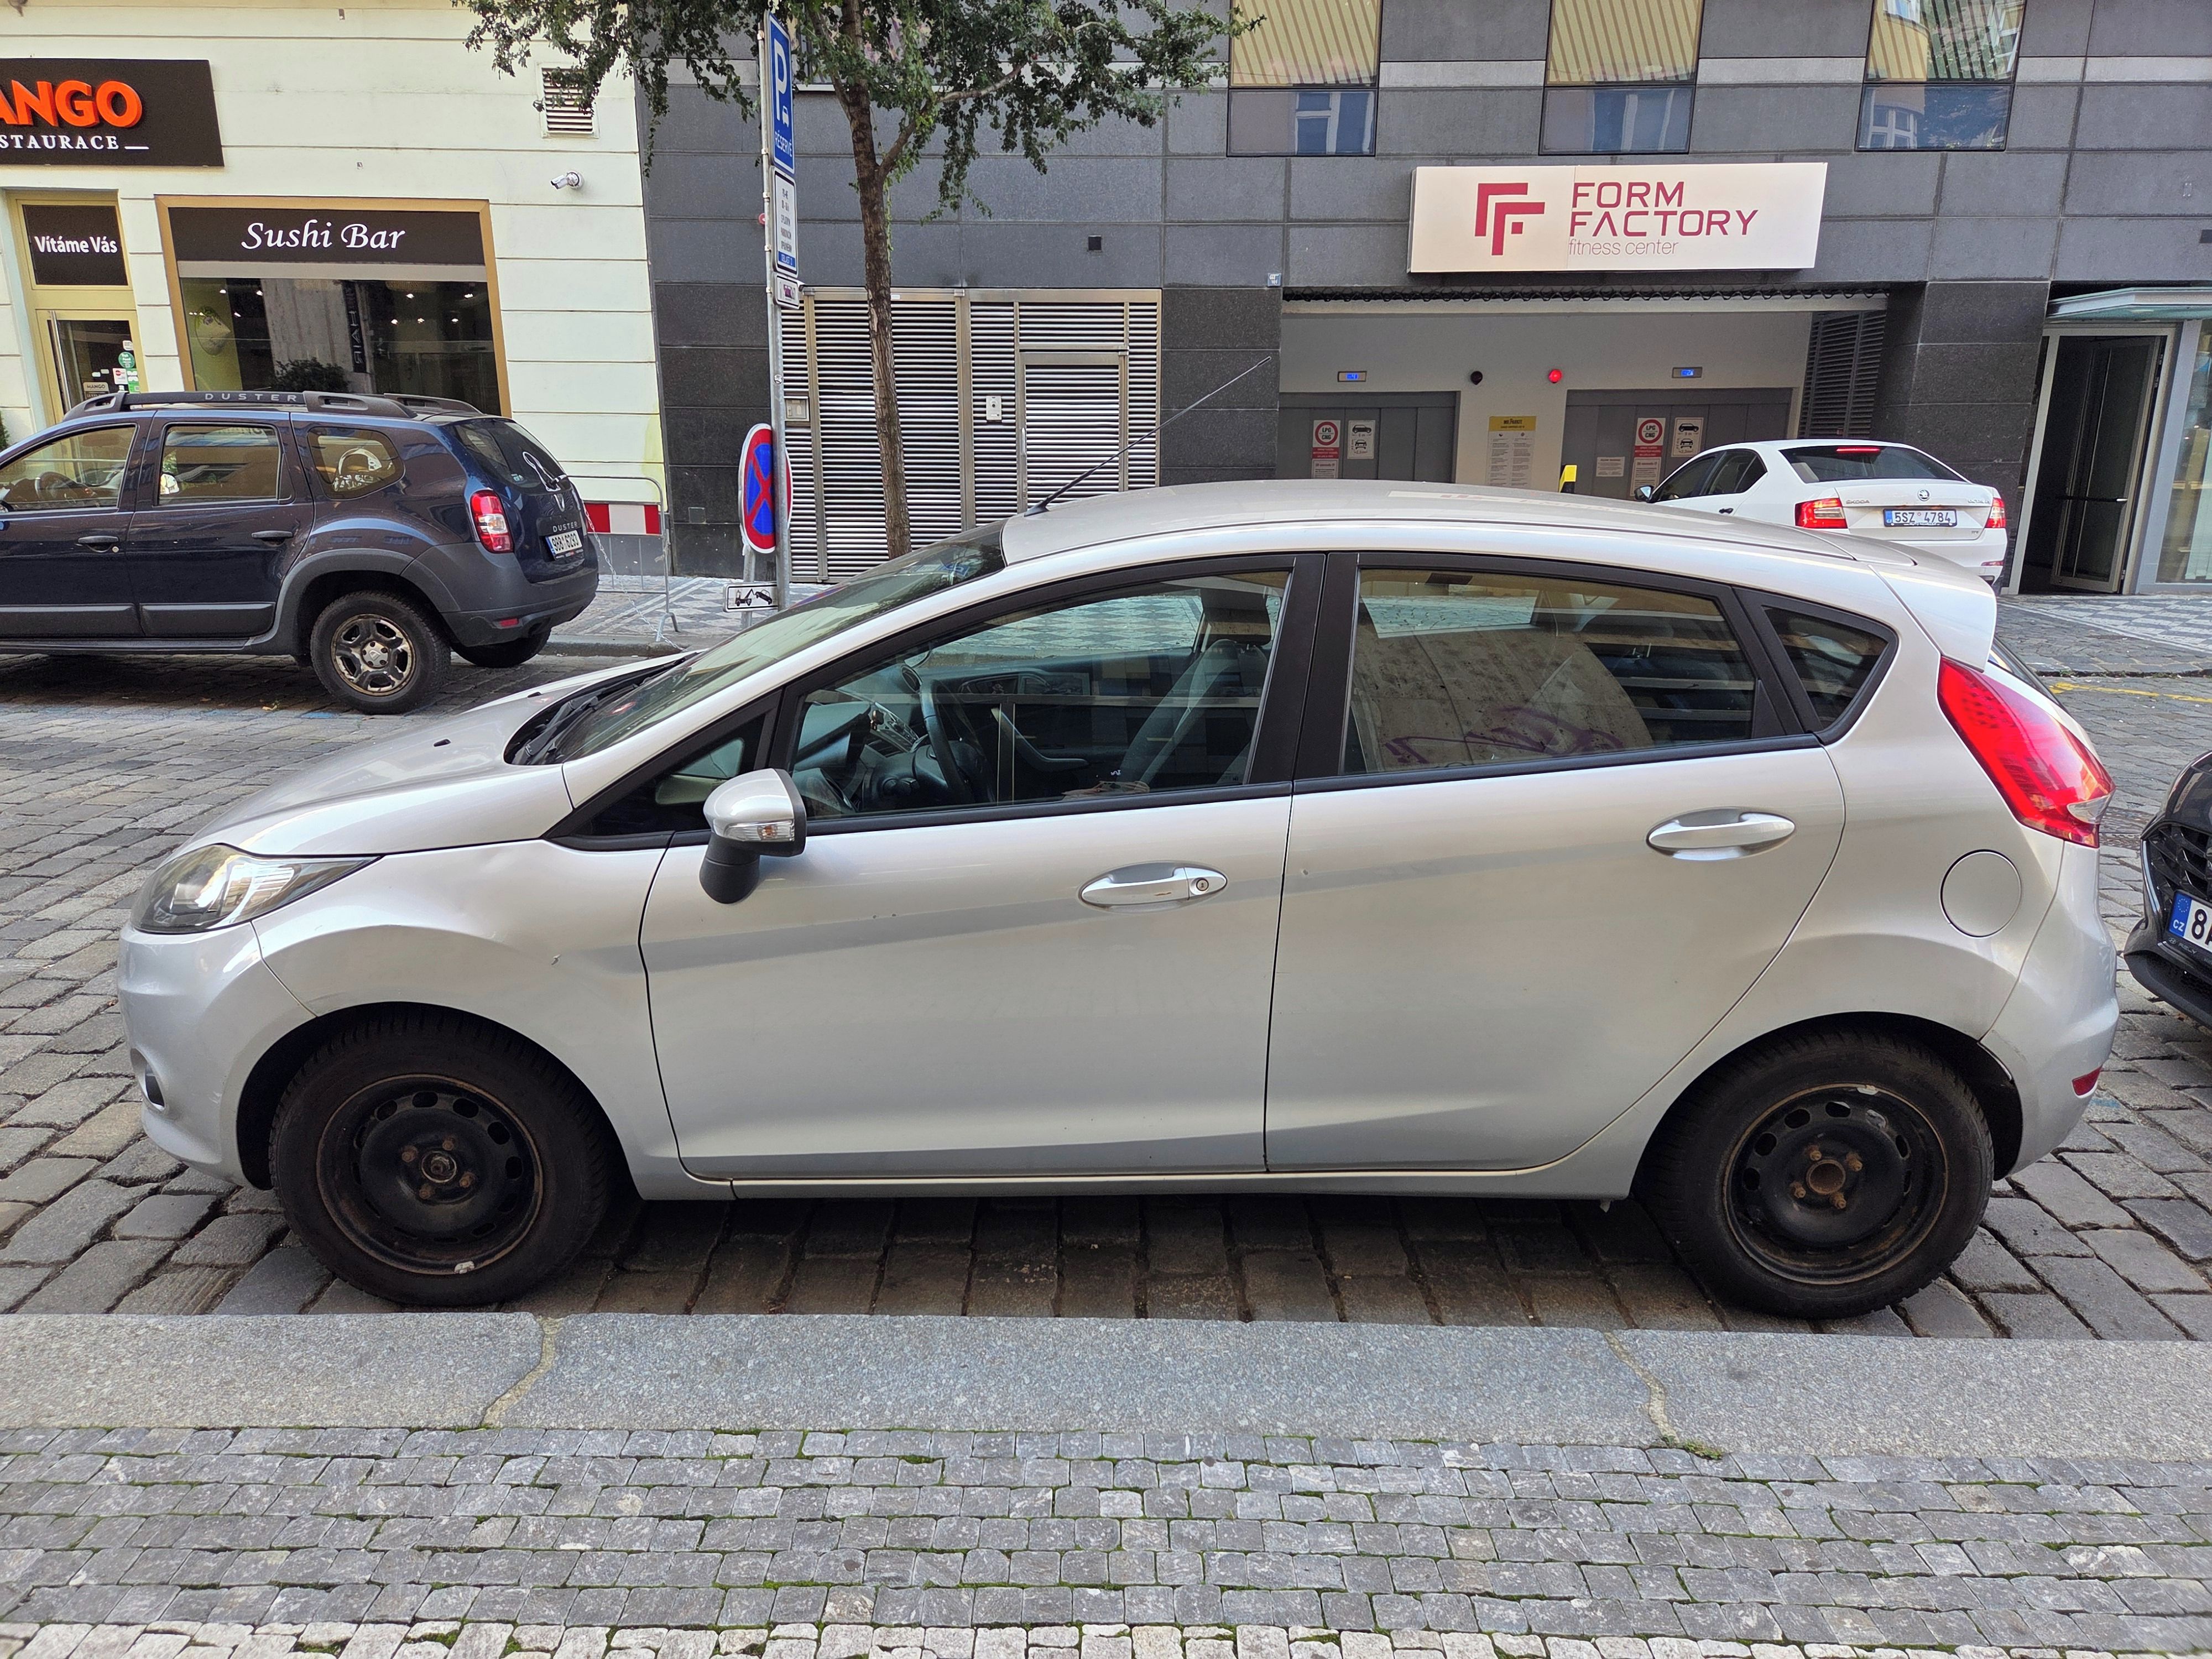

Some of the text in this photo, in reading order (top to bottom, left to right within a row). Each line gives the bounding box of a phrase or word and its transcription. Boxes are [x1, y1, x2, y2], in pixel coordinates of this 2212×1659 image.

[774, 38, 788, 121] P
[1572, 181, 1684, 208] FORM
[1569, 210, 1759, 237] FACTORY
[241, 220, 405, 249] Sushi Bar
[34, 236, 117, 253] Vítáme Vás
[1569, 238, 1679, 255] fitness center
[205, 393, 298, 403] DUSTER
[1895, 512, 1951, 523] 5SZ 4784
[553, 521, 578, 533] DUSTER
[2173, 919, 2185, 932] CZ
